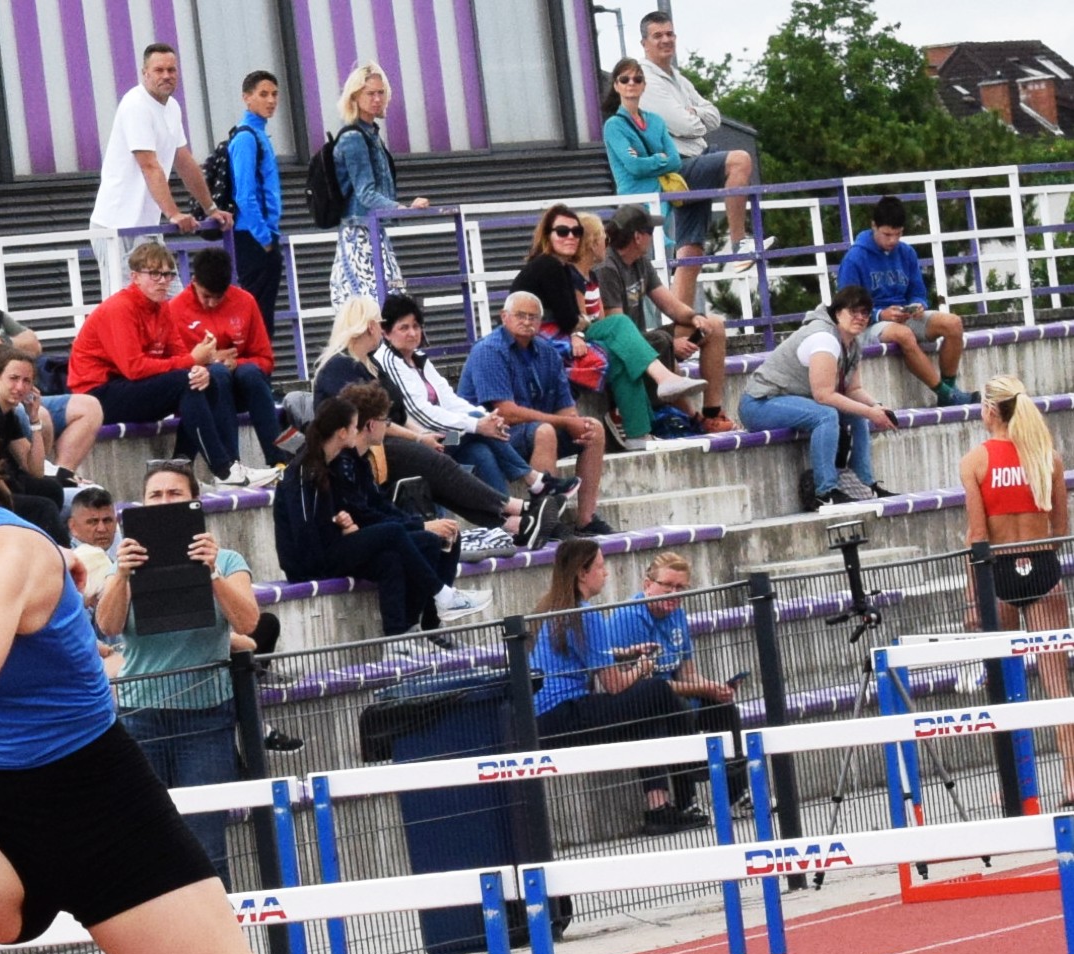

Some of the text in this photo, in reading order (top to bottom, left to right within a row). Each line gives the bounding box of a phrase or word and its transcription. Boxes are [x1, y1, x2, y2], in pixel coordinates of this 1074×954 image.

[1011, 634, 1074, 655] DIMA
[914, 712, 996, 737] DIMA
[478, 756, 558, 780] DIMA
[745, 842, 853, 875] DIMA
